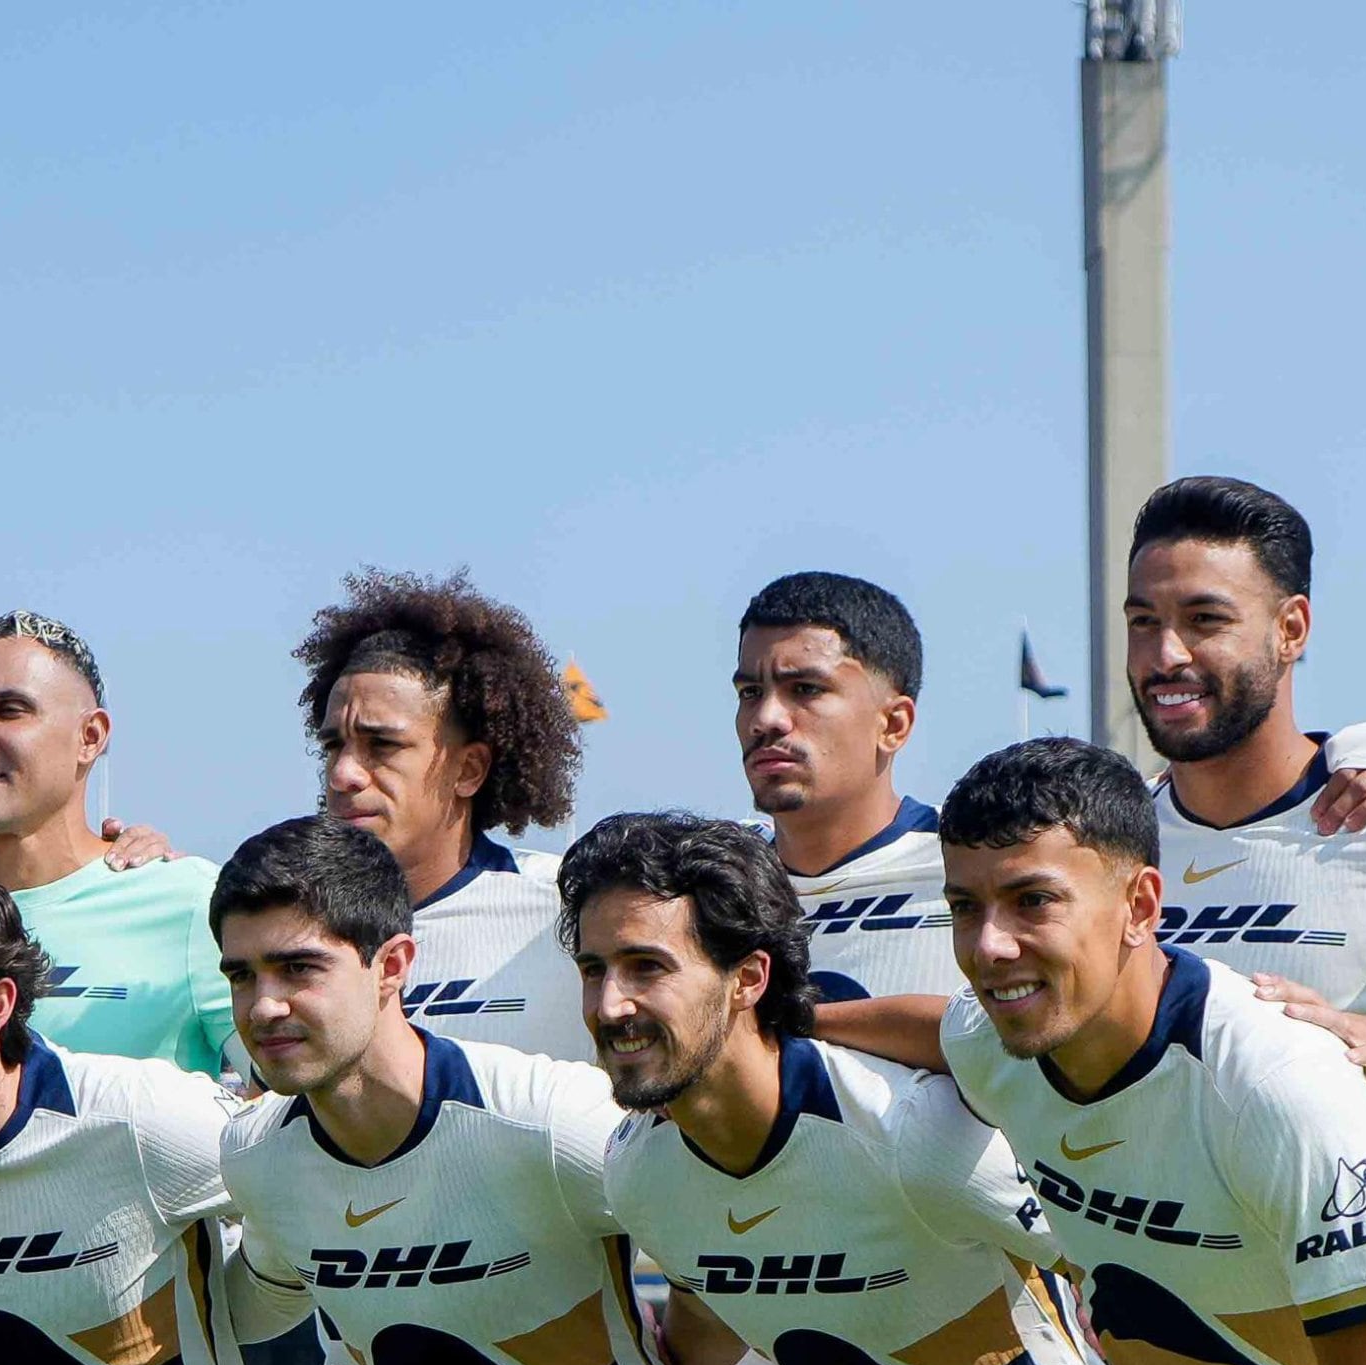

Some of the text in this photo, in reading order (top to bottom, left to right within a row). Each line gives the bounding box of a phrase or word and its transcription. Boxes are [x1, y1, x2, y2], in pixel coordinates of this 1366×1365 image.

[802, 893, 924, 935] HL
[1033, 1158, 1202, 1248] DHL
[309, 1239, 491, 1289] DHL
[697, 1252, 867, 1295] DHL
